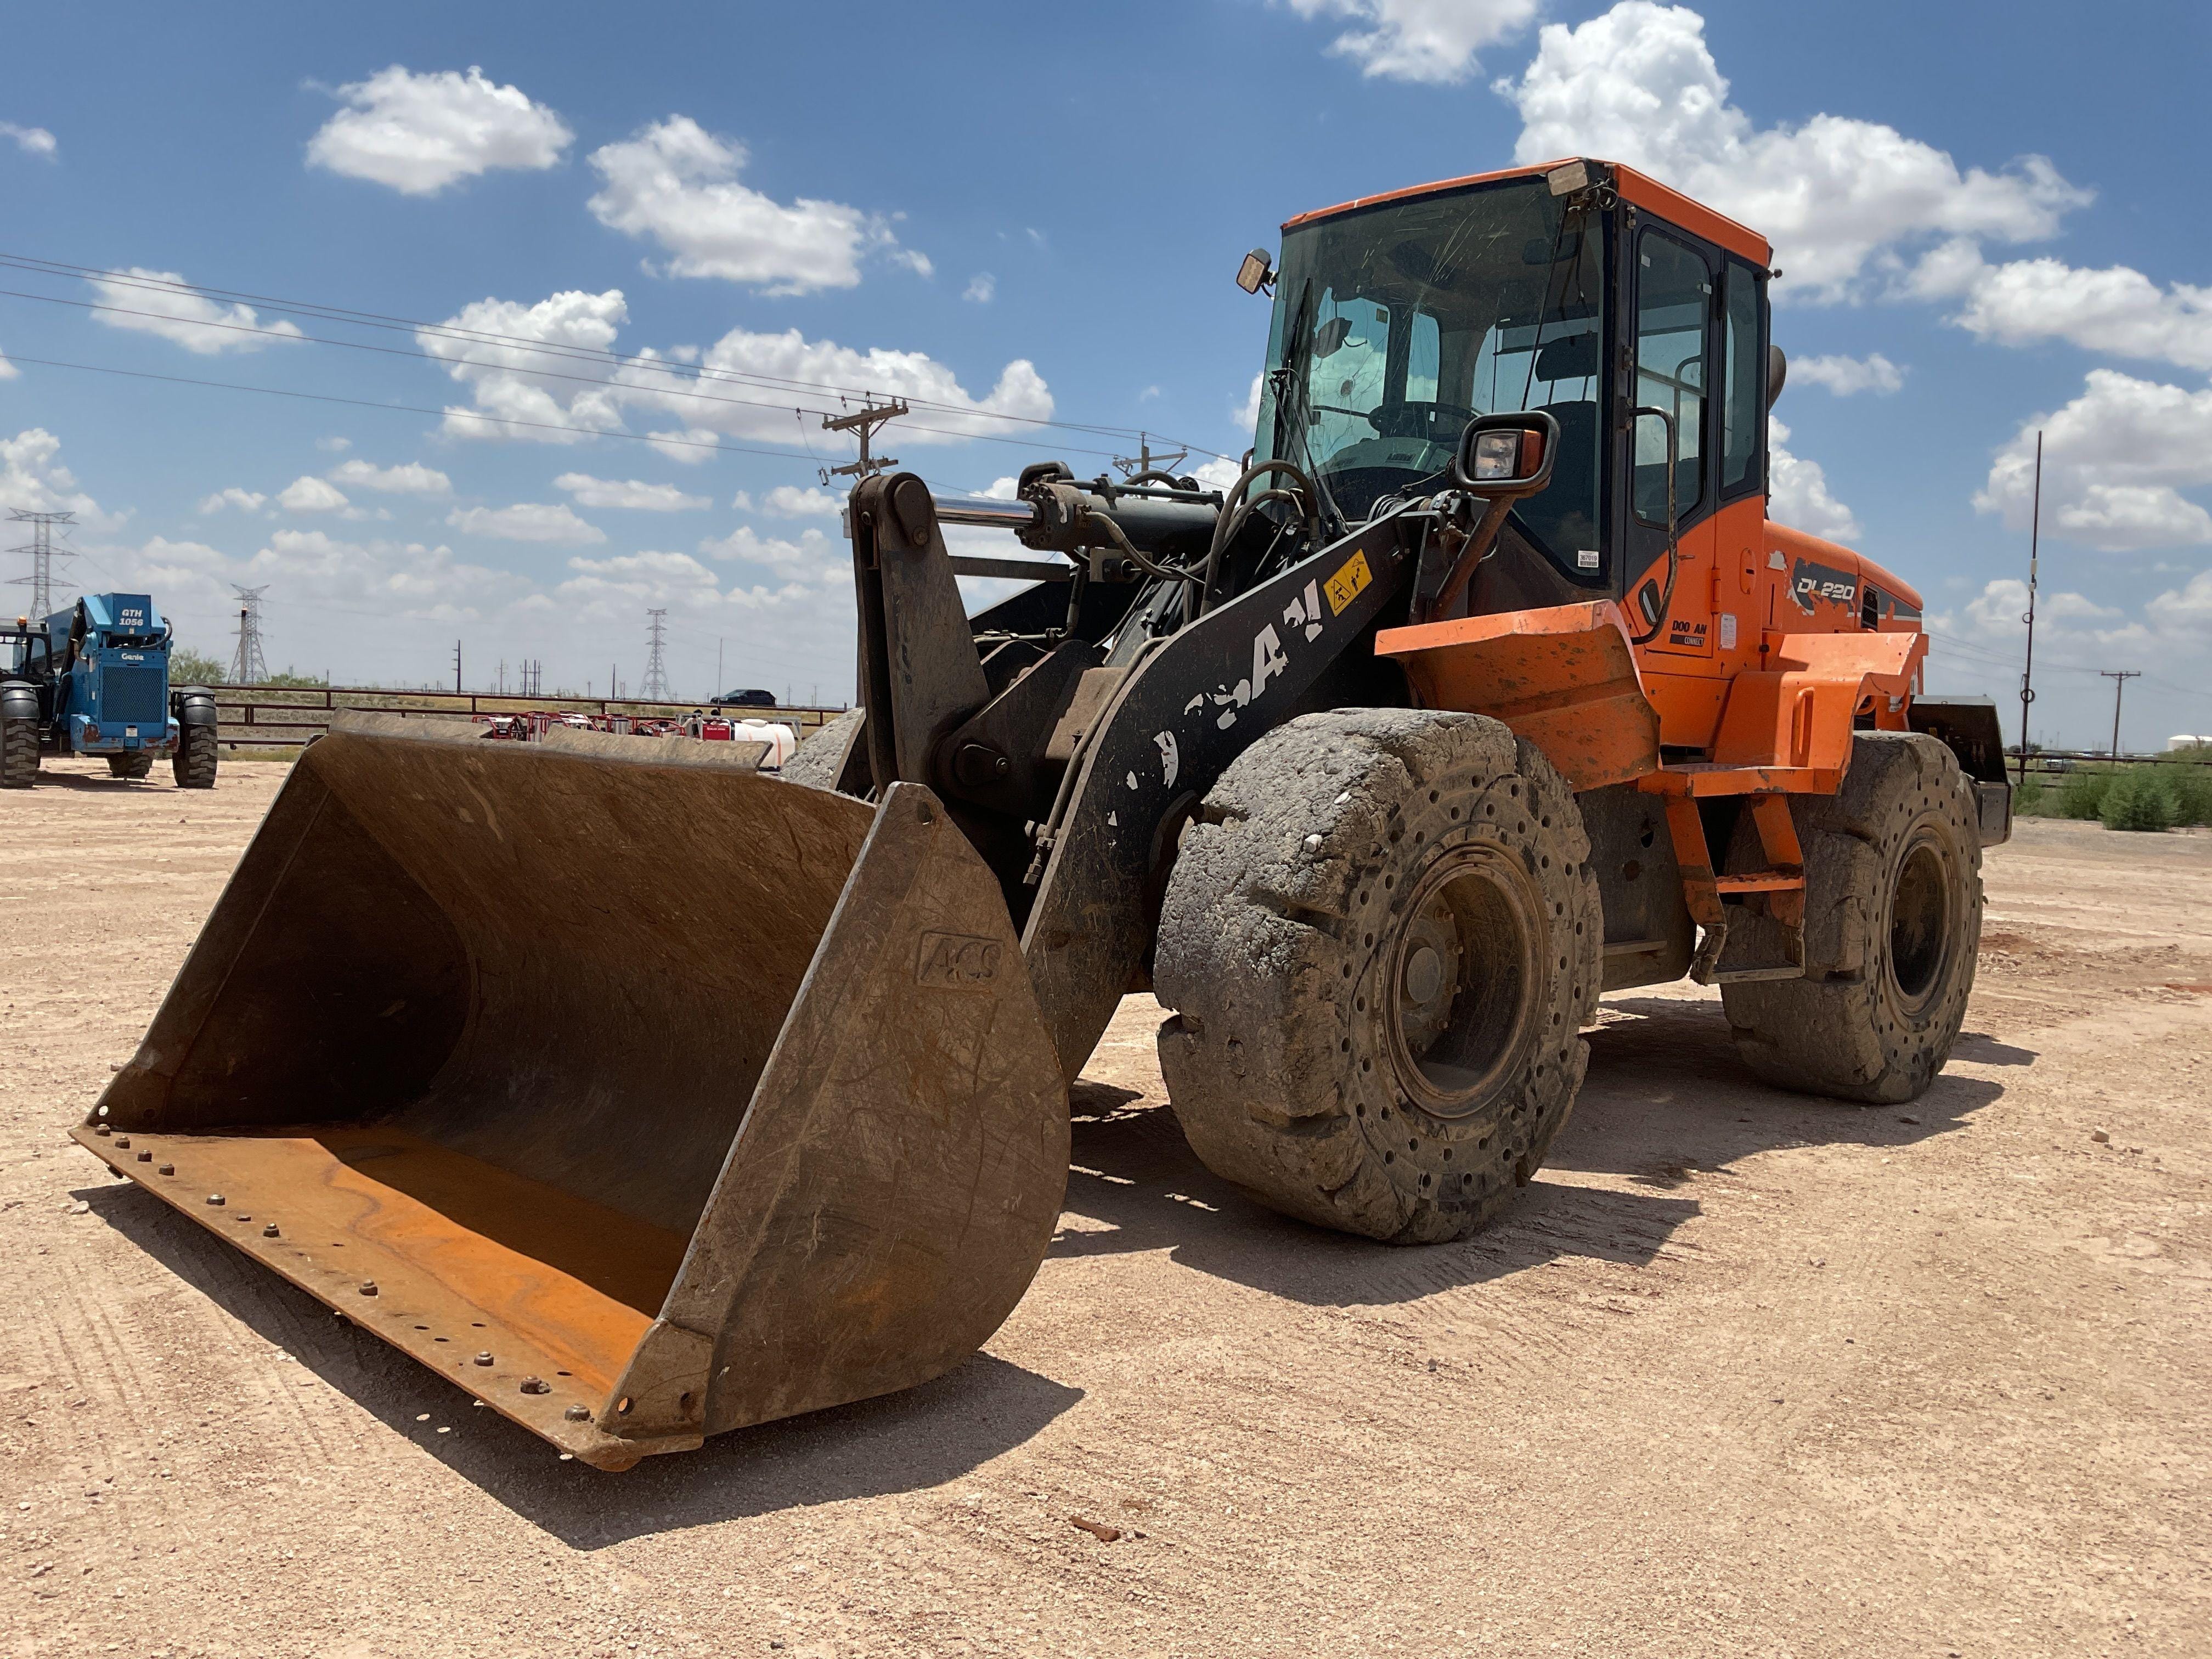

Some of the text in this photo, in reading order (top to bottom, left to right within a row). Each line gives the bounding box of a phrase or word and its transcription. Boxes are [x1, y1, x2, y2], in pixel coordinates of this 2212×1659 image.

[1797, 578, 1855, 600] DL220
[121, 609, 143, 617] GTH
[1672, 620, 1707, 634] DOOAN
[1684, 636, 1703, 646] CONNECT
